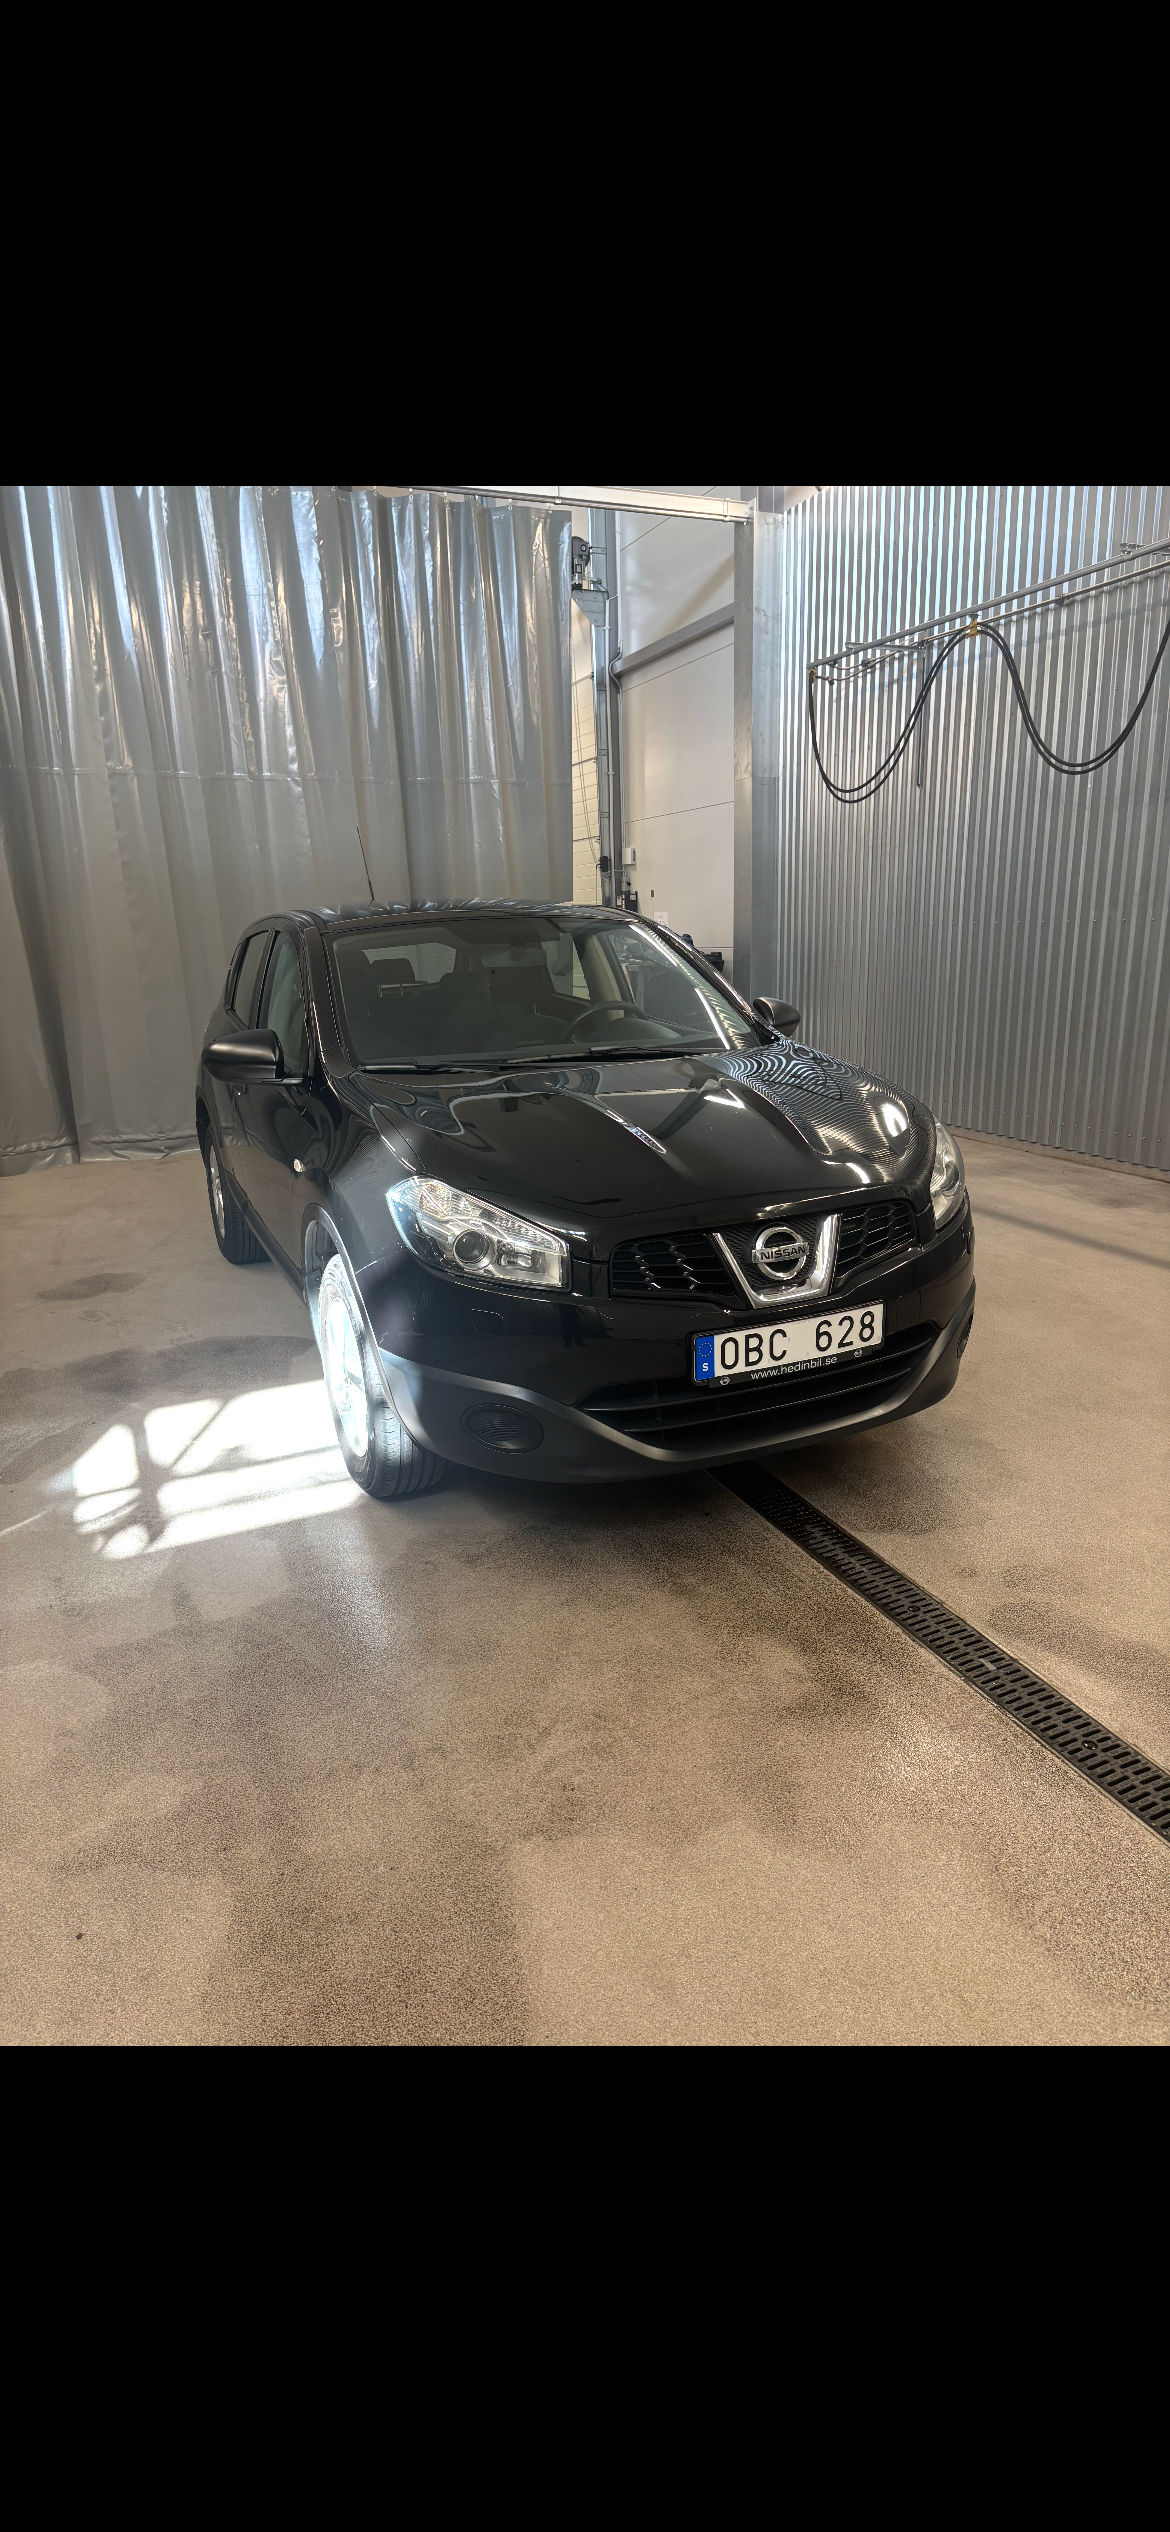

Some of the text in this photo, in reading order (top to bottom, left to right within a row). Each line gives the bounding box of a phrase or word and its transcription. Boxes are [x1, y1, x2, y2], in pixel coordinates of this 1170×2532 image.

[760, 1245, 806, 1261] NISSAN
[720, 1310, 875, 1370] OBC 628
[702, 1363, 709, 1372] S
[750, 1356, 838, 1380] www.hedinbil.se
